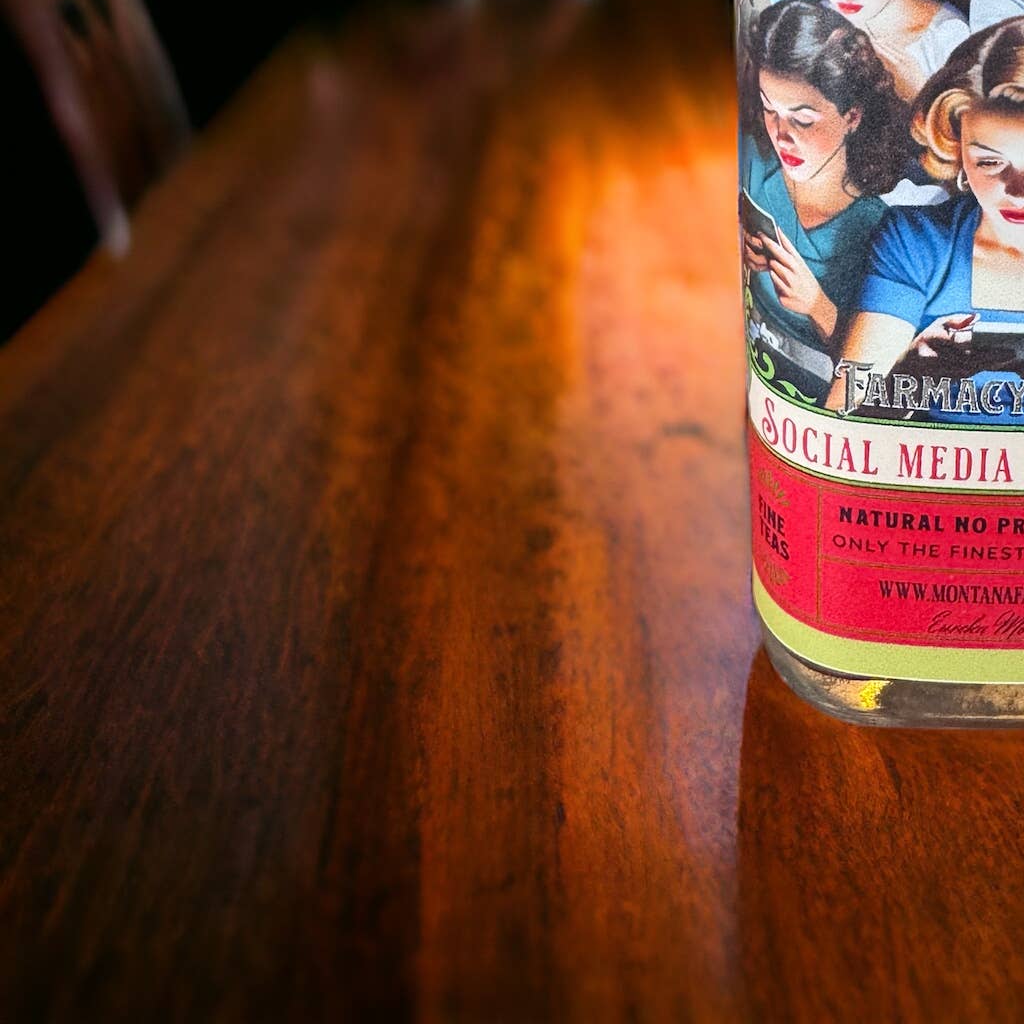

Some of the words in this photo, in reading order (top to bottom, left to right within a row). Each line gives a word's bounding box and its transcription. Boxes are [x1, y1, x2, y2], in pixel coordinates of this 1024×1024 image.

[761, 396, 879, 476] SOCIAL
[897, 442, 1014, 484] MEDIA
[758, 493, 786, 538] FINE
[760, 515, 791, 561] TEAS
[838, 505, 945, 533] NATURAL
[954, 516, 988, 535] NO
[831, 534, 890, 554] ONLY
[898, 541, 942, 559] THE
